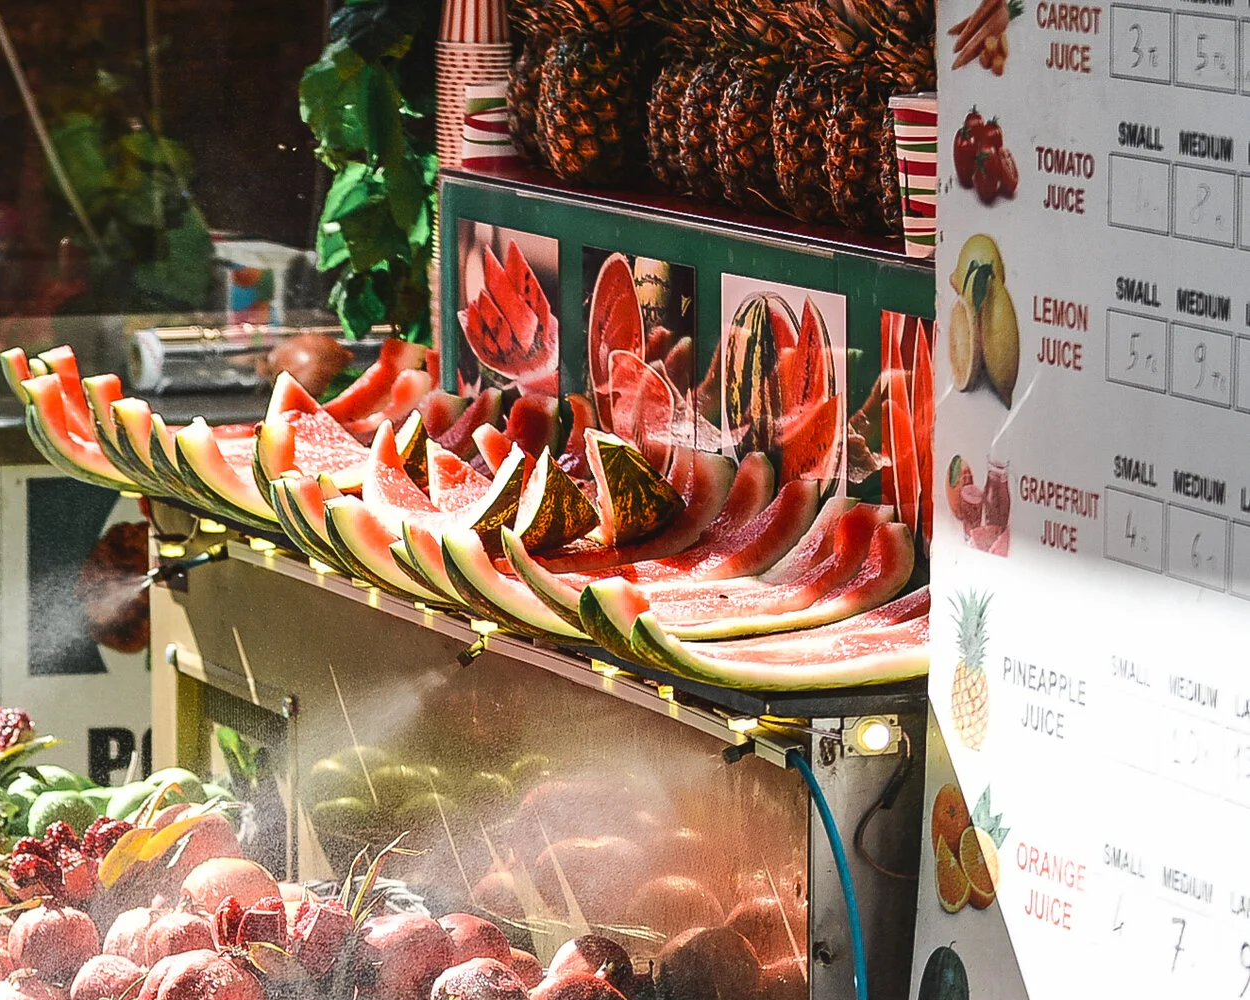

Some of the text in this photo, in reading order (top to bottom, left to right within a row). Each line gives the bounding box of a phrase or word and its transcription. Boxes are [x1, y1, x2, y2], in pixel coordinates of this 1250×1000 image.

[1035, 1, 1102, 35] CARROT
[1045, 42, 1091, 73] JUICE
[1117, 121, 1164, 152] SMALL
[1178, 130, 1234, 162] MEDIUM
[1036, 146, 1095, 180] TOMATO
[1043, 184, 1086, 215] JUICE
[1032, 295, 1089, 332] LEMON
[1115, 276, 1162, 308] SMALL
[1176, 287, 1232, 322] MEDIUM
[1037, 336, 1083, 371] JUICE
[1019, 474, 1100, 520] GRAPEFRUIT
[1113, 454, 1158, 488] SMALL
[1172, 469, 1227, 506] MEDIUM
[1040, 519, 1079, 552] JUICE
[1003, 656, 1087, 707] PINEAPPLE
[1111, 654, 1150, 688] SMALL
[1168, 674, 1218, 709] MEDIUM
[1021, 703, 1065, 740] JUICE
[88, 727, 152, 787] P
[1016, 842, 1087, 893] ORANGE
[1103, 843, 1146, 879] SMALL
[1161, 866, 1214, 903] MEDIUM
[1024, 889, 1073, 931] JUICE
[1171, 917, 1186, 972] 7
